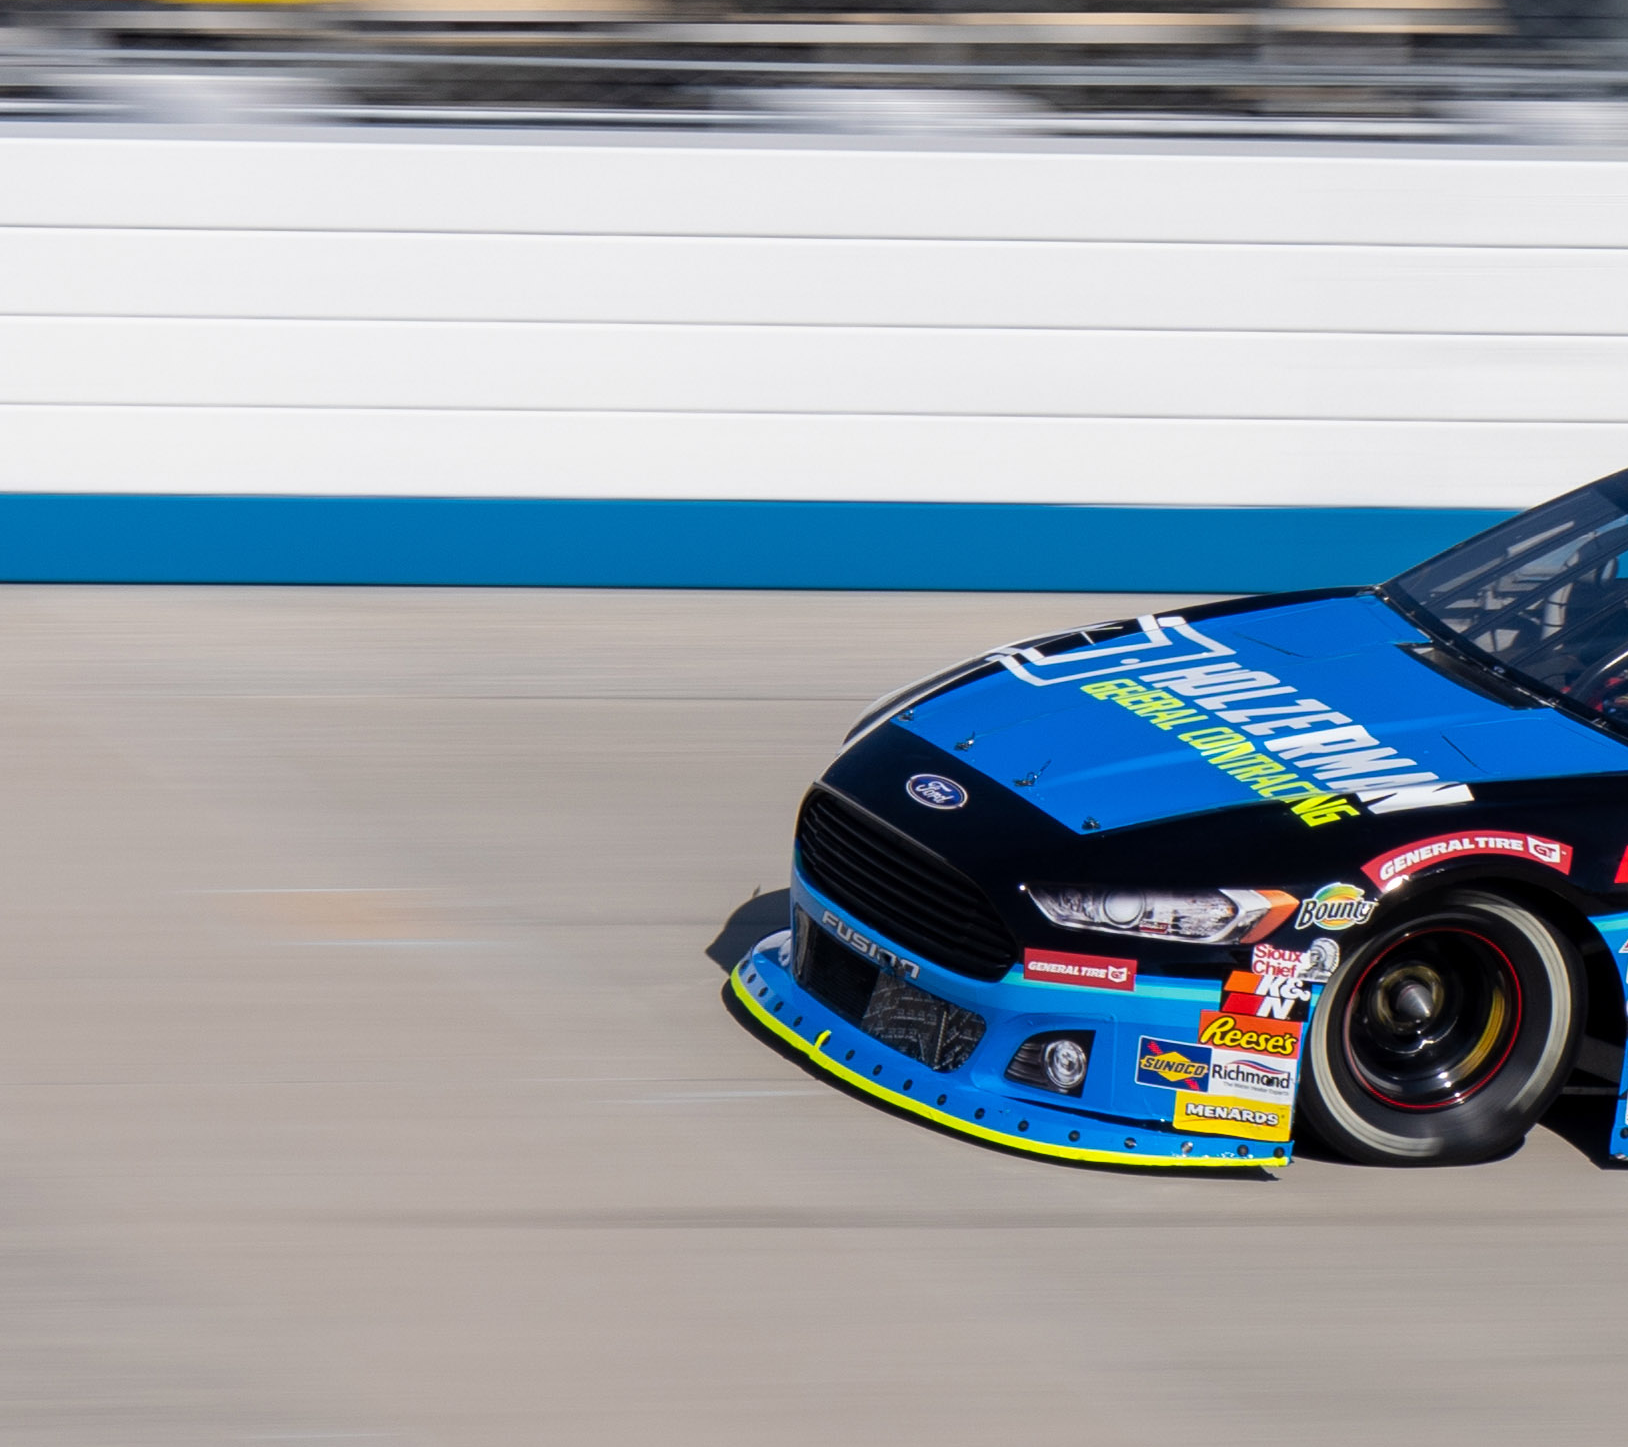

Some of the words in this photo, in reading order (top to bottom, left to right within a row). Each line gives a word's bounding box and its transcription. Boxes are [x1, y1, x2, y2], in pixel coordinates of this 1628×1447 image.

[1080, 678, 1210, 730] GENERAL
[1139, 662, 1475, 815] HOLZERMAN
[1380, 838, 1475, 881] GENERAL
[1474, 837, 1524, 852] TIRE
[1296, 897, 1376, 930] Bounty
[1254, 944, 1302, 964] Sioux
[1028, 960, 1079, 976] GENERAL
[1080, 964, 1108, 980] TIRE
[1253, 959, 1298, 978] Chief
[1199, 1016, 1298, 1055] Reese's
[1142, 1057, 1208, 1077] SUNOCO
[1212, 1064, 1291, 1090] Richmond
[1186, 1102, 1280, 1127] MENARDS
